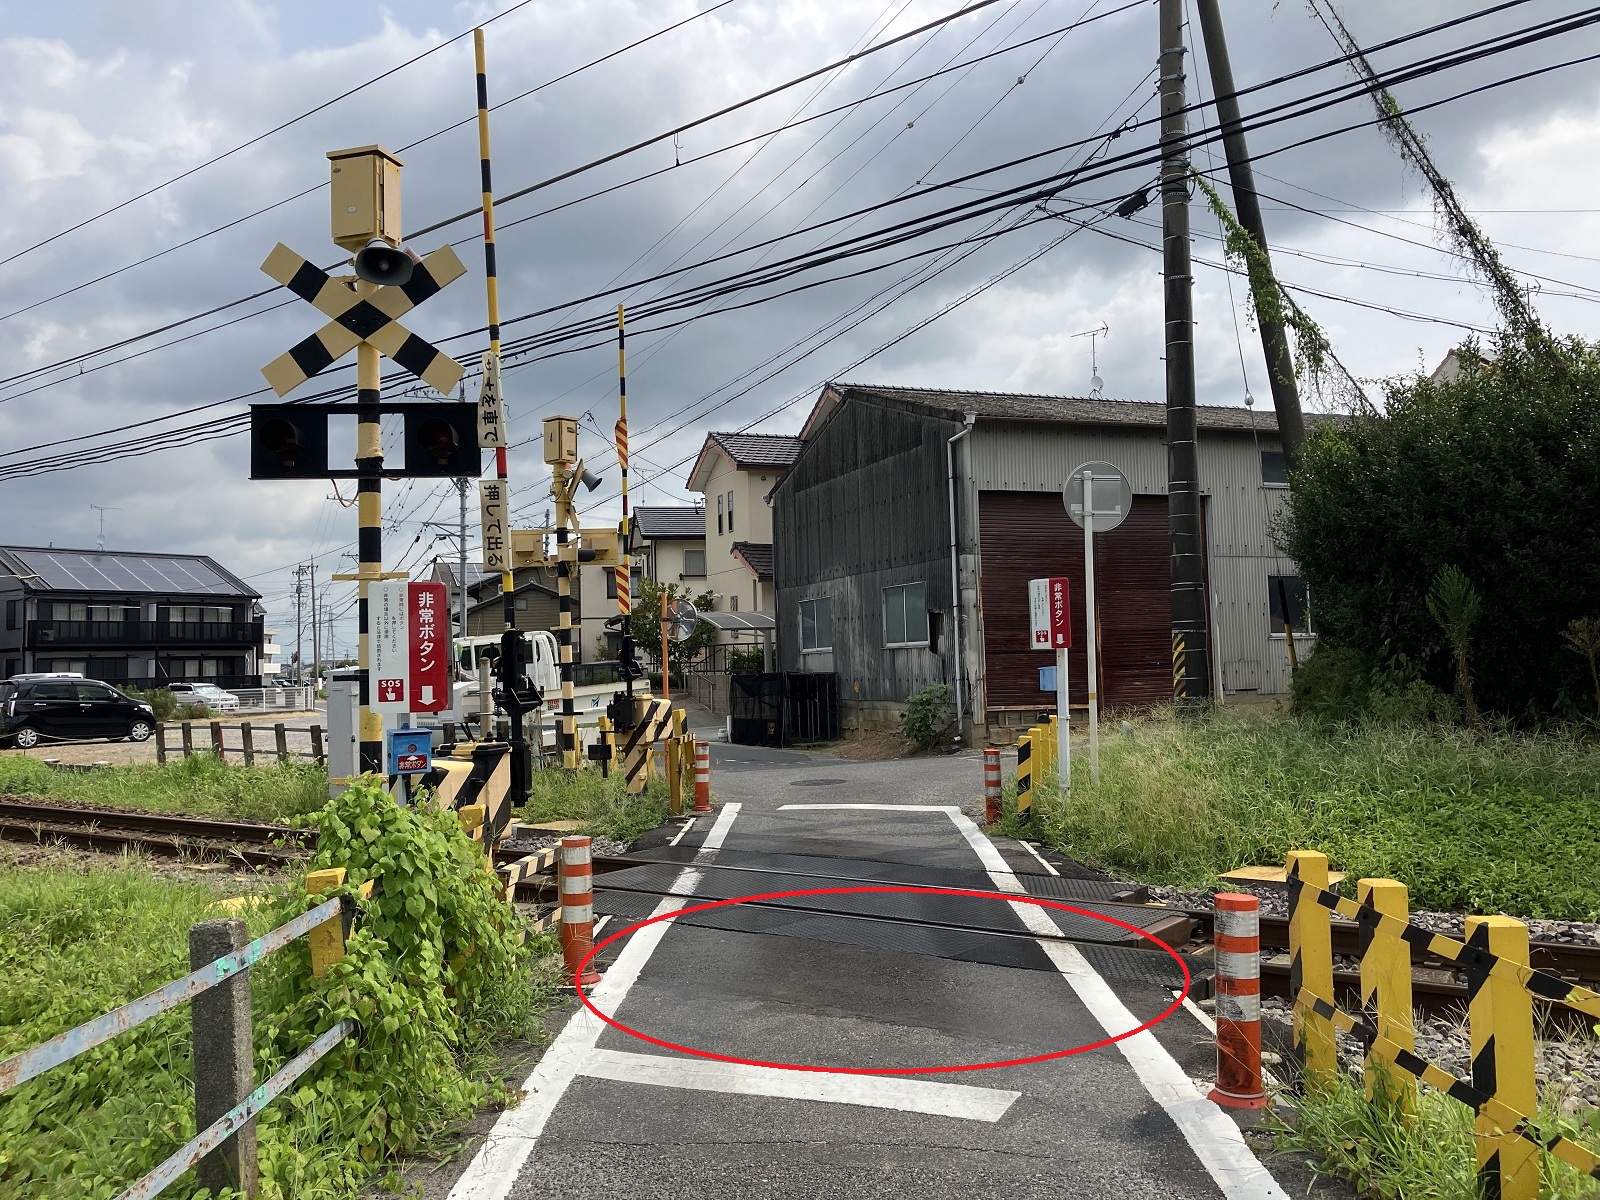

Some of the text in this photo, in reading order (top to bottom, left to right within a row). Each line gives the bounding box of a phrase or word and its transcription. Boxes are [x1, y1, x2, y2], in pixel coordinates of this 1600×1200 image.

[484, 485, 503, 566] 押して出る
[418, 592, 436, 671] 非常ボタン
[1054, 583, 1063, 627] 非常ボタン
[381, 680, 401, 688] SOS
